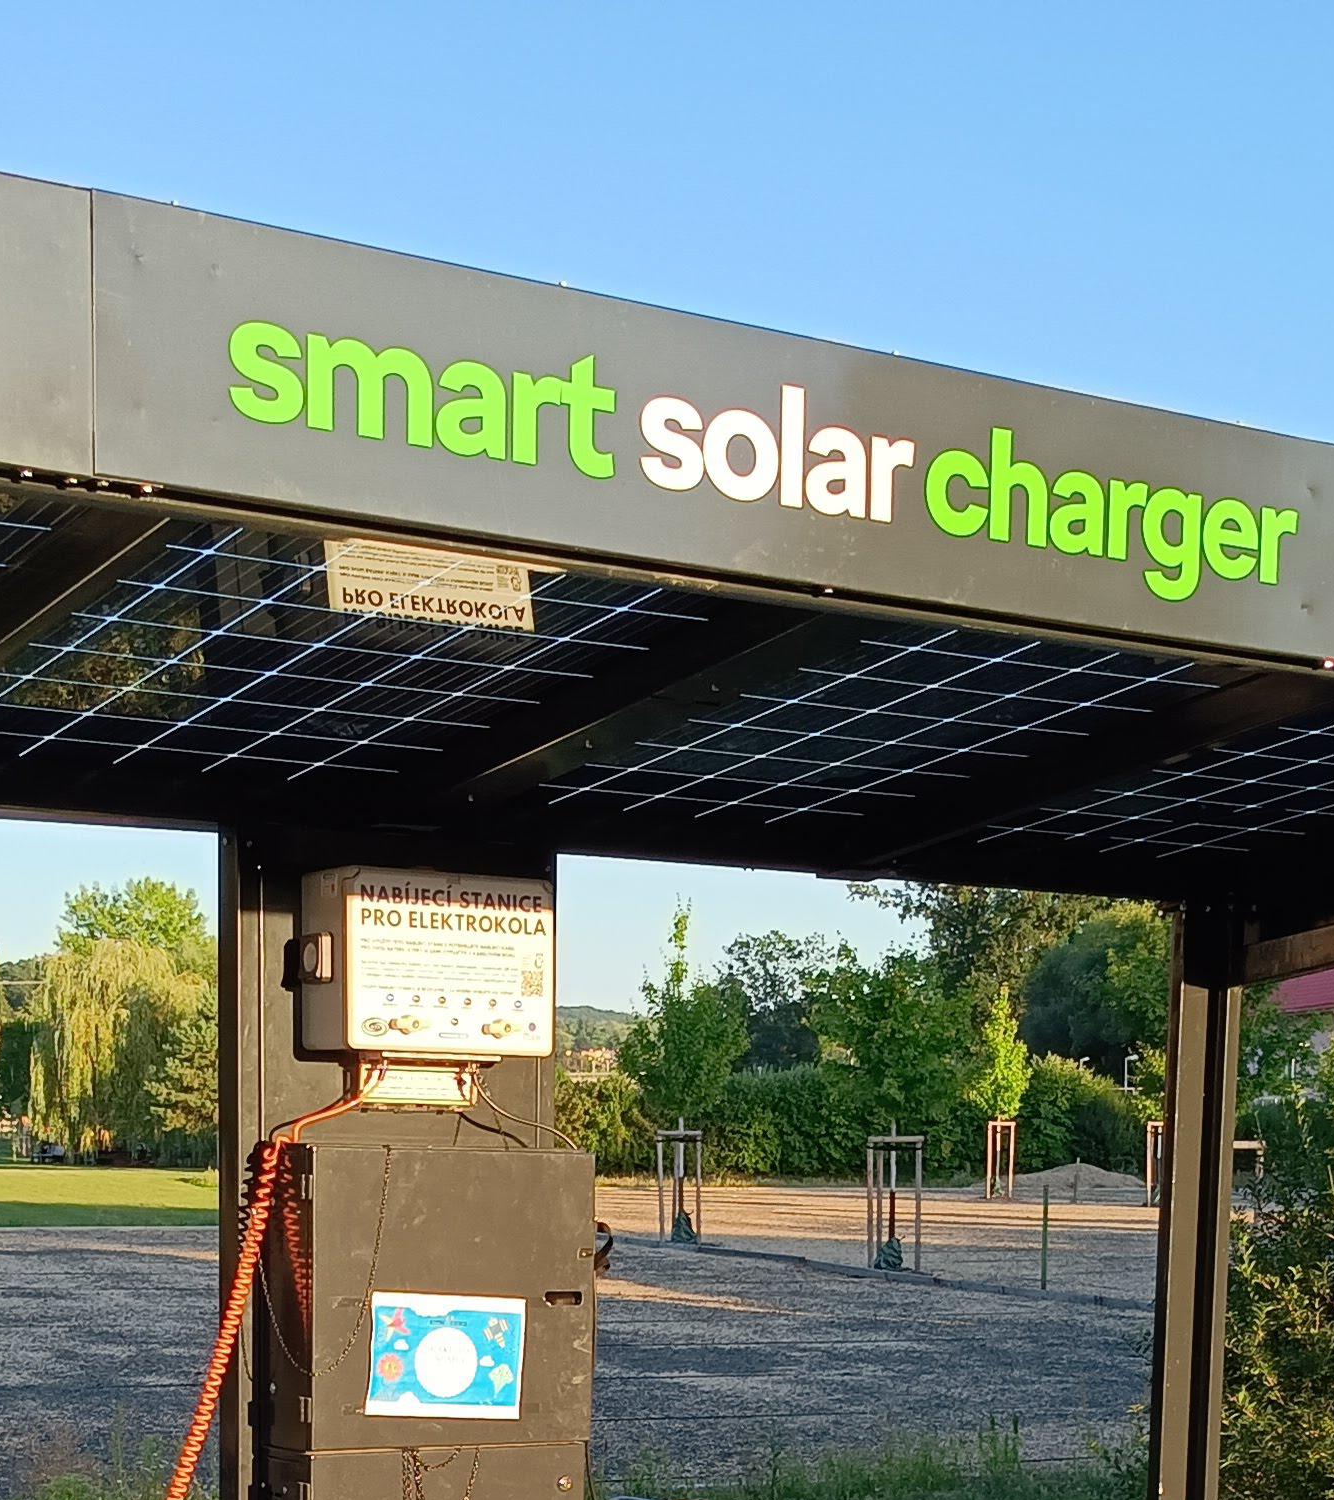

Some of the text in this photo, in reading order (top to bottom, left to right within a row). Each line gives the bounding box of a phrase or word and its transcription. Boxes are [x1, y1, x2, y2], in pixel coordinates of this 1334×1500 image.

[227, 319, 1299, 602] smart solar charger
[360, 881, 543, 913] NABÍJECÍ STANICE
[361, 908, 547, 936] PRO ELEKTROKOLA
